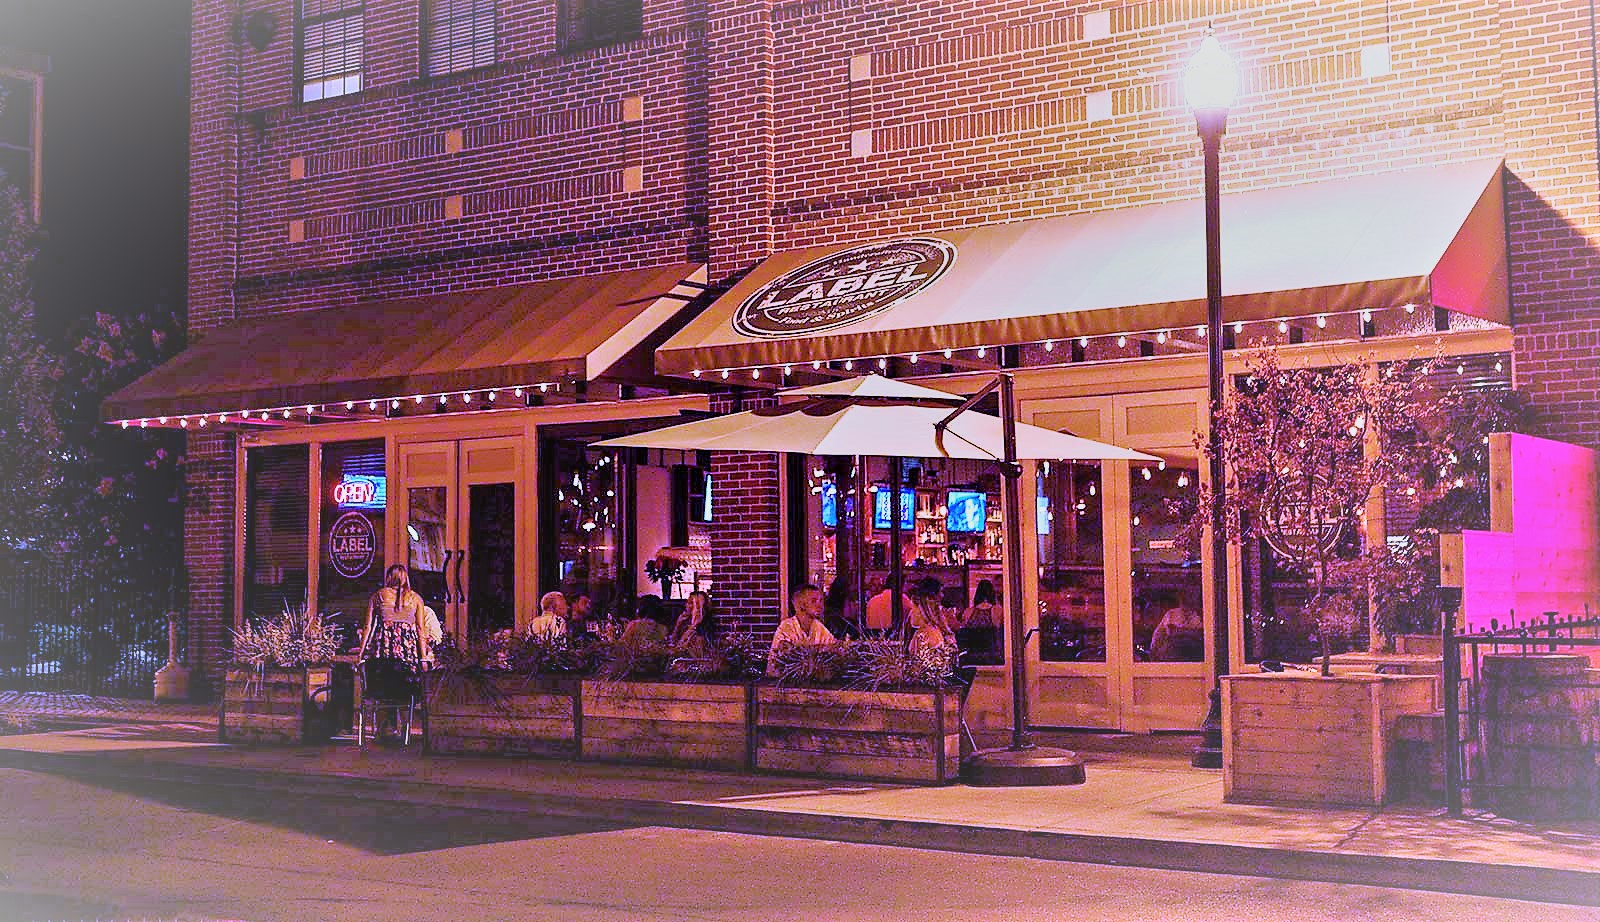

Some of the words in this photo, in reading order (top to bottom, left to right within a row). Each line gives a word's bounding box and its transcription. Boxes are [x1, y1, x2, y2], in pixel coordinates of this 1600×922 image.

[757, 264, 928, 309] LABEL
[777, 288, 890, 315] RESTAURANT
[333, 484, 373, 503] OPEN
[332, 537, 373, 553] LABEL
